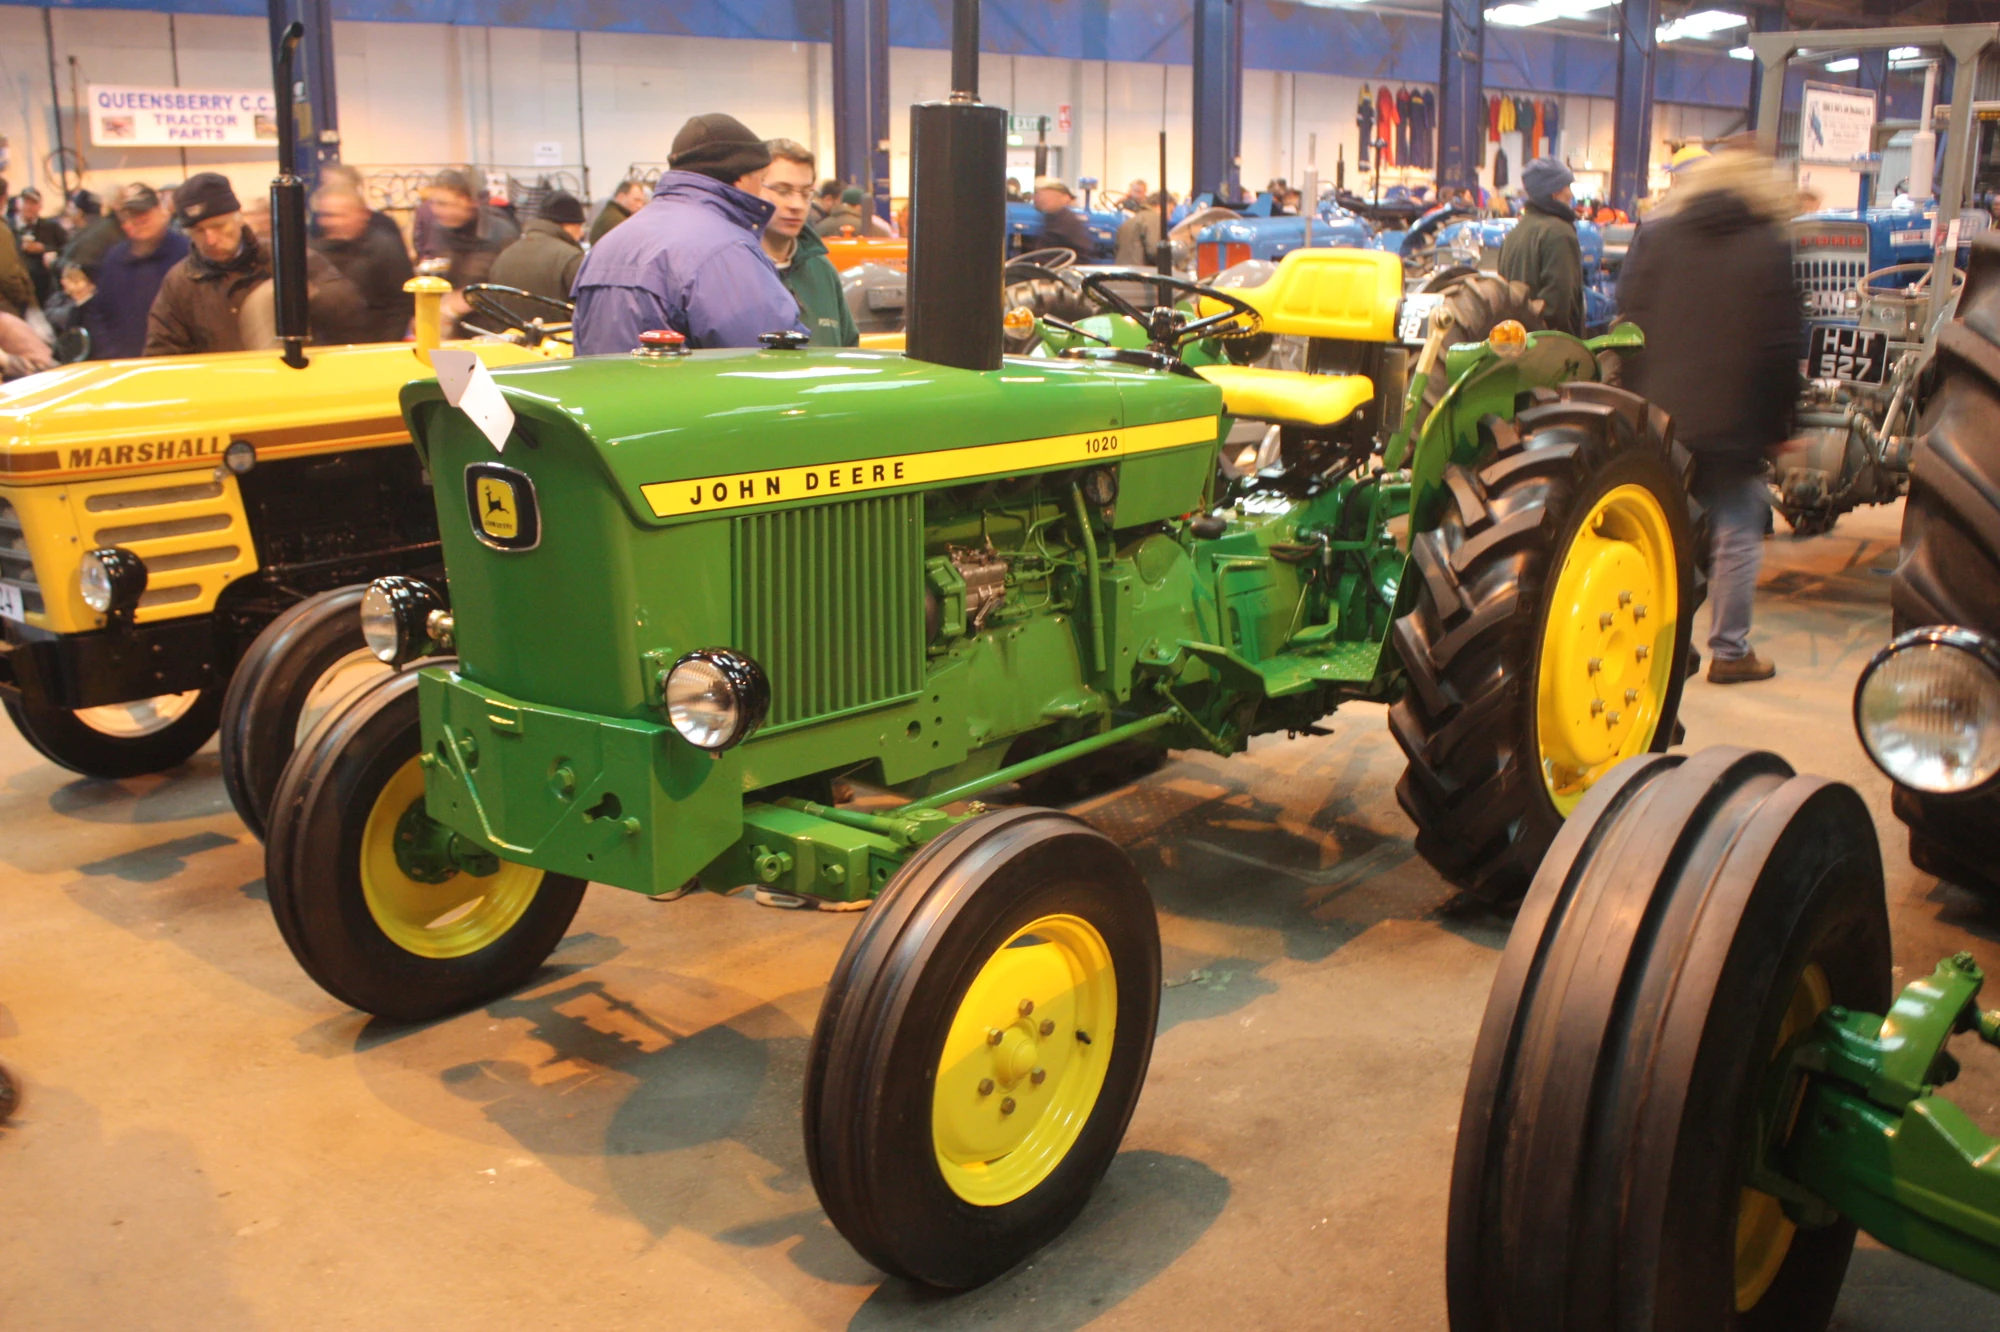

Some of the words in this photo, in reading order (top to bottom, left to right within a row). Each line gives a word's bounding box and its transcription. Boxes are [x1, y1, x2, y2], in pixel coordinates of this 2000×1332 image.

[99, 92, 233, 110] QUEENSBERRY
[155, 114, 237, 125] TRACTOR
[169, 128, 225, 139] PARTS
[1823, 328, 1876, 356] HJT
[1820, 353, 1872, 380] 527
[69, 436, 223, 469] MARSHALL
[1086, 435, 1118, 453] 1020
[690, 476, 780, 506] JOHN
[806, 462, 904, 490] DEERE
